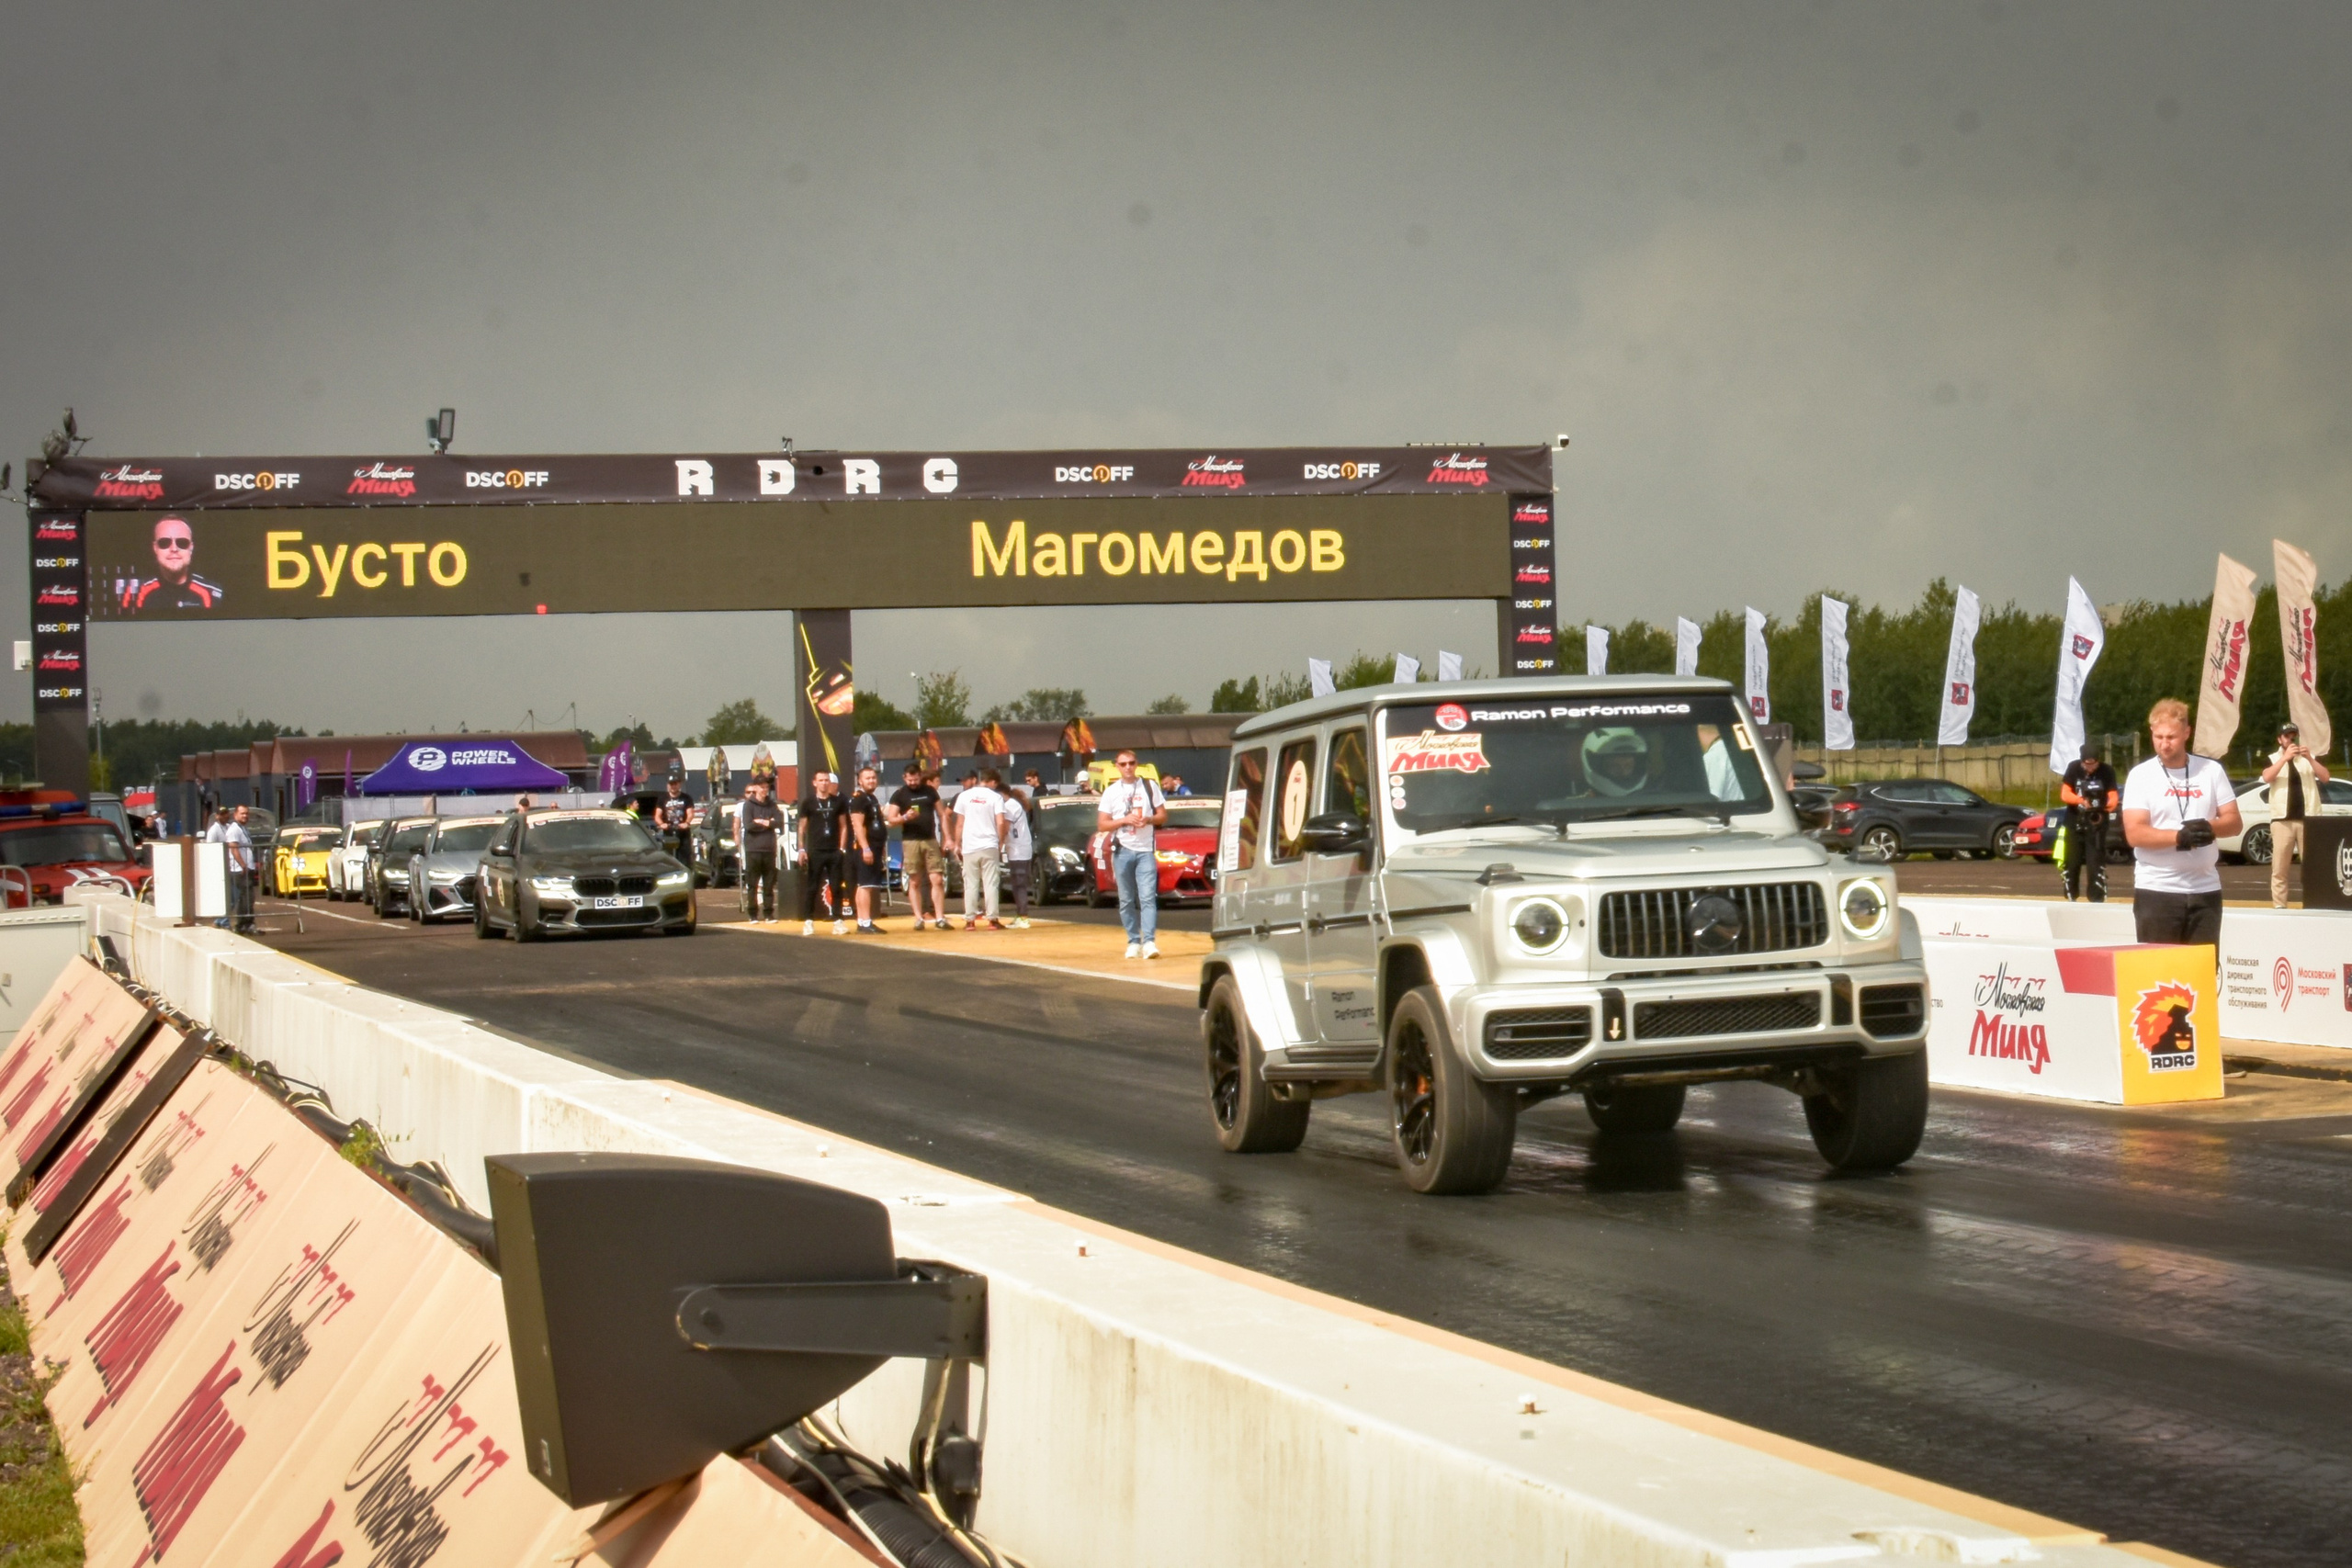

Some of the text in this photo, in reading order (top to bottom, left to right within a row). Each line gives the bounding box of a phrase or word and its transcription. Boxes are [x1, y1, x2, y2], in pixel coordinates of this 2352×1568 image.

[971, 520, 1345, 581] Магомедов
[266, 531, 468, 597] Бусто
[1472, 704, 1690, 721] Ramon Performance
[451, 757, 516, 765] WHEELS
[452, 750, 509, 759] POWER
[1389, 751, 1489, 771] Миля
[2226, 955, 2259, 966] Московская
[2227, 971, 2254, 981] дирекция
[2298, 966, 2336, 980] Московский
[1974, 962, 2046, 1018] Московская
[2227, 985, 2267, 996] транспортного
[2298, 984, 2330, 997] транспорт
[2228, 997, 2267, 1010] обслуживания
[1968, 1010, 2051, 1075] Миля
[2151, 1055, 2195, 1068] RDRC
